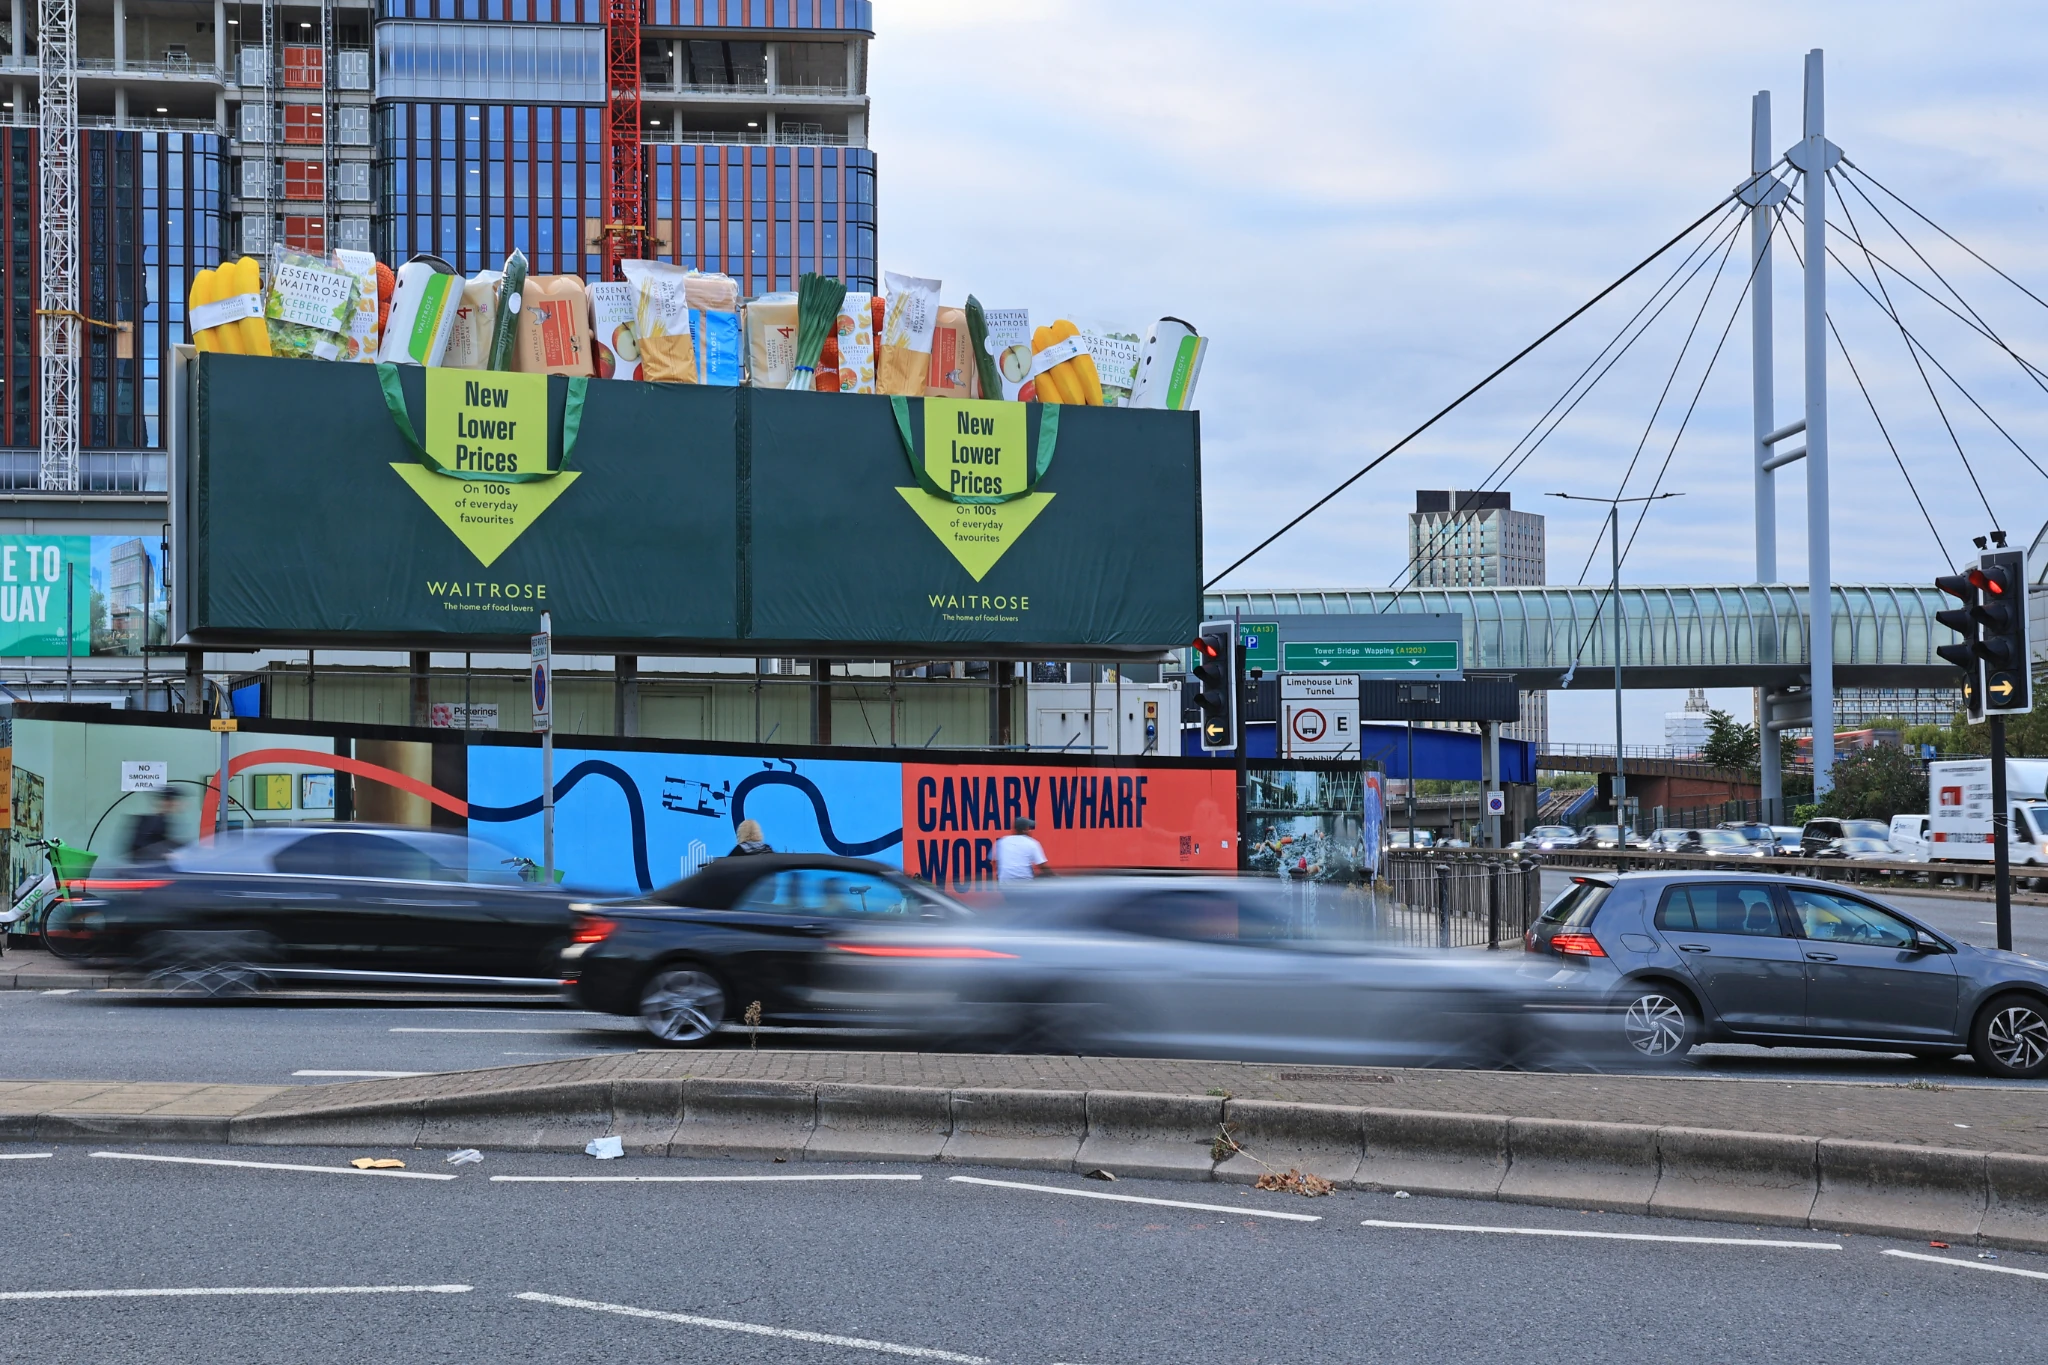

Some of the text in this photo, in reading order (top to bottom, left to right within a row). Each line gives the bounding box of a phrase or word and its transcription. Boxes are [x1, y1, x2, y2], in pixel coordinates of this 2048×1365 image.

[281, 267, 348, 289] ESSENTIAL
[280, 278, 347, 300] WAITROSE
[595, 286, 628, 294] ESSENT
[281, 297, 328, 314] ICEBERG
[661, 281, 671, 317] WAITROSE
[283, 308, 333, 327] LETTUCE
[416, 295, 434, 335] WAITROSE
[457, 307, 472, 320] 4
[598, 315, 622, 325] JUICE
[912, 297, 921, 333] WAITROSE
[985, 312, 1028, 320] ESSENTIAL
[777, 326, 794, 339] 4
[532, 329, 540, 363] WAITROSE
[1081, 335, 1137, 353] ESSENTIAL
[1096, 363, 1126, 375] EBERG
[1172, 355, 1186, 389] WAITROSE
[1102, 373, 1133, 387] TTUCE
[465, 381, 509, 408] New
[458, 412, 516, 441] Lower
[957, 411, 994, 436] New
[456, 444, 518, 473] Prices
[952, 440, 1001, 465] Lower
[463, 484, 511, 495] On 100s
[950, 469, 1003, 495] Prices
[455, 498, 518, 513] of everyday
[956, 505, 997, 516] On 100s
[460, 513, 514, 525] favourites
[950, 519, 1004, 531] of everyday
[954, 532, 1000, 543] favourites
[4, 546, 60, 582] E TO
[427, 581, 546, 599] WAITROSE
[1, 586, 50, 622] UAY
[444, 602, 534, 613] The home of food lovers
[928, 594, 1030, 610] WAITROSE
[942, 613, 1019, 623] The home of food lovers
[1239, 625, 1274, 634] ity (A13)
[1314, 647, 1427, 656] Tower Bridge Wapping (A1203)
[1287, 678, 1353, 686] Limehouse Link
[1305, 687, 1335, 695] Tunnel
[1337, 716, 1348, 731] E
[917, 776, 1148, 832] CANARY WHARF
[17, 889, 43, 911] Lime
